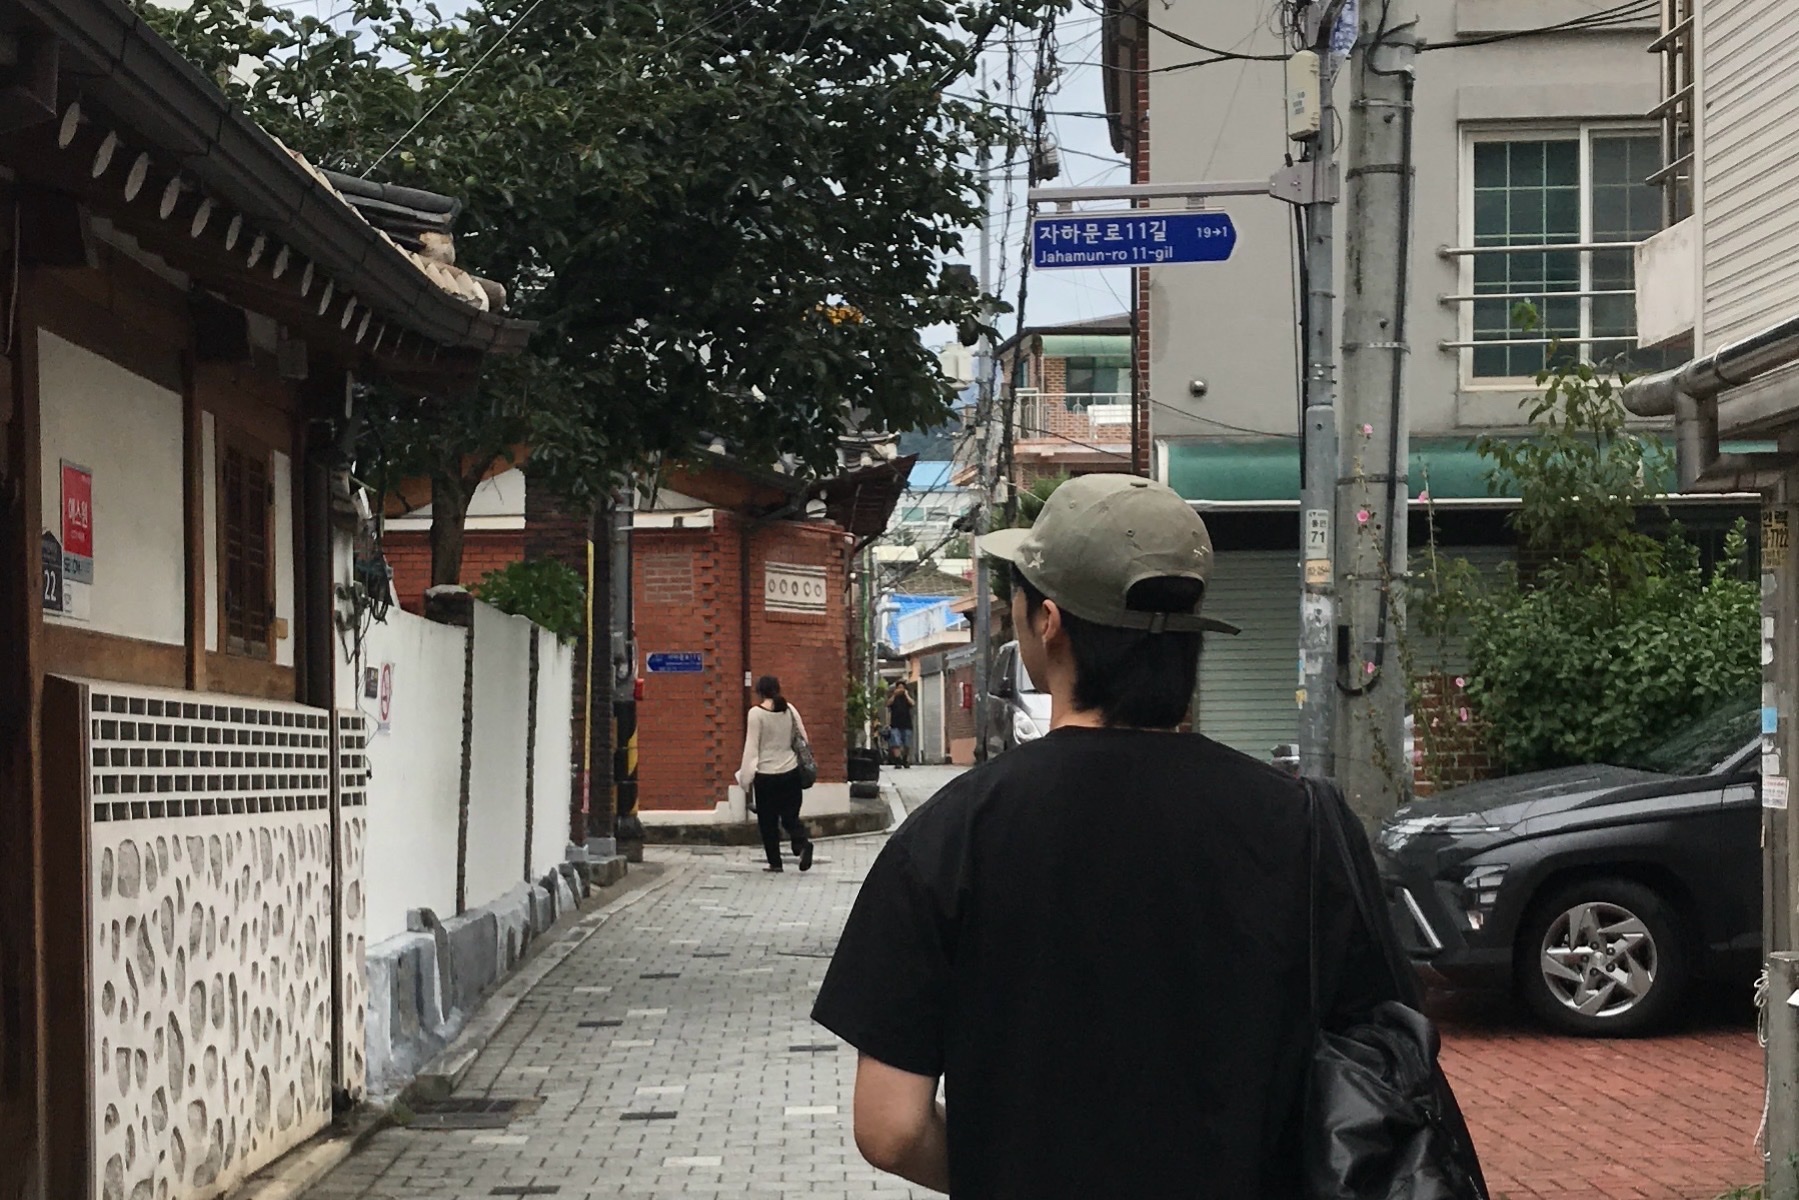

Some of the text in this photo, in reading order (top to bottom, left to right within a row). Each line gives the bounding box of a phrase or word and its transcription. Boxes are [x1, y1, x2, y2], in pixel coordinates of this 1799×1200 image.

[1040, 220, 1167, 245] 자하문로11길
[1197, 226, 1227, 238] 19 1
[1040, 245, 1173, 263] Jahamun-ro 11-gil
[1311, 530, 1325, 543] 71
[44, 569, 57, 602] 22
